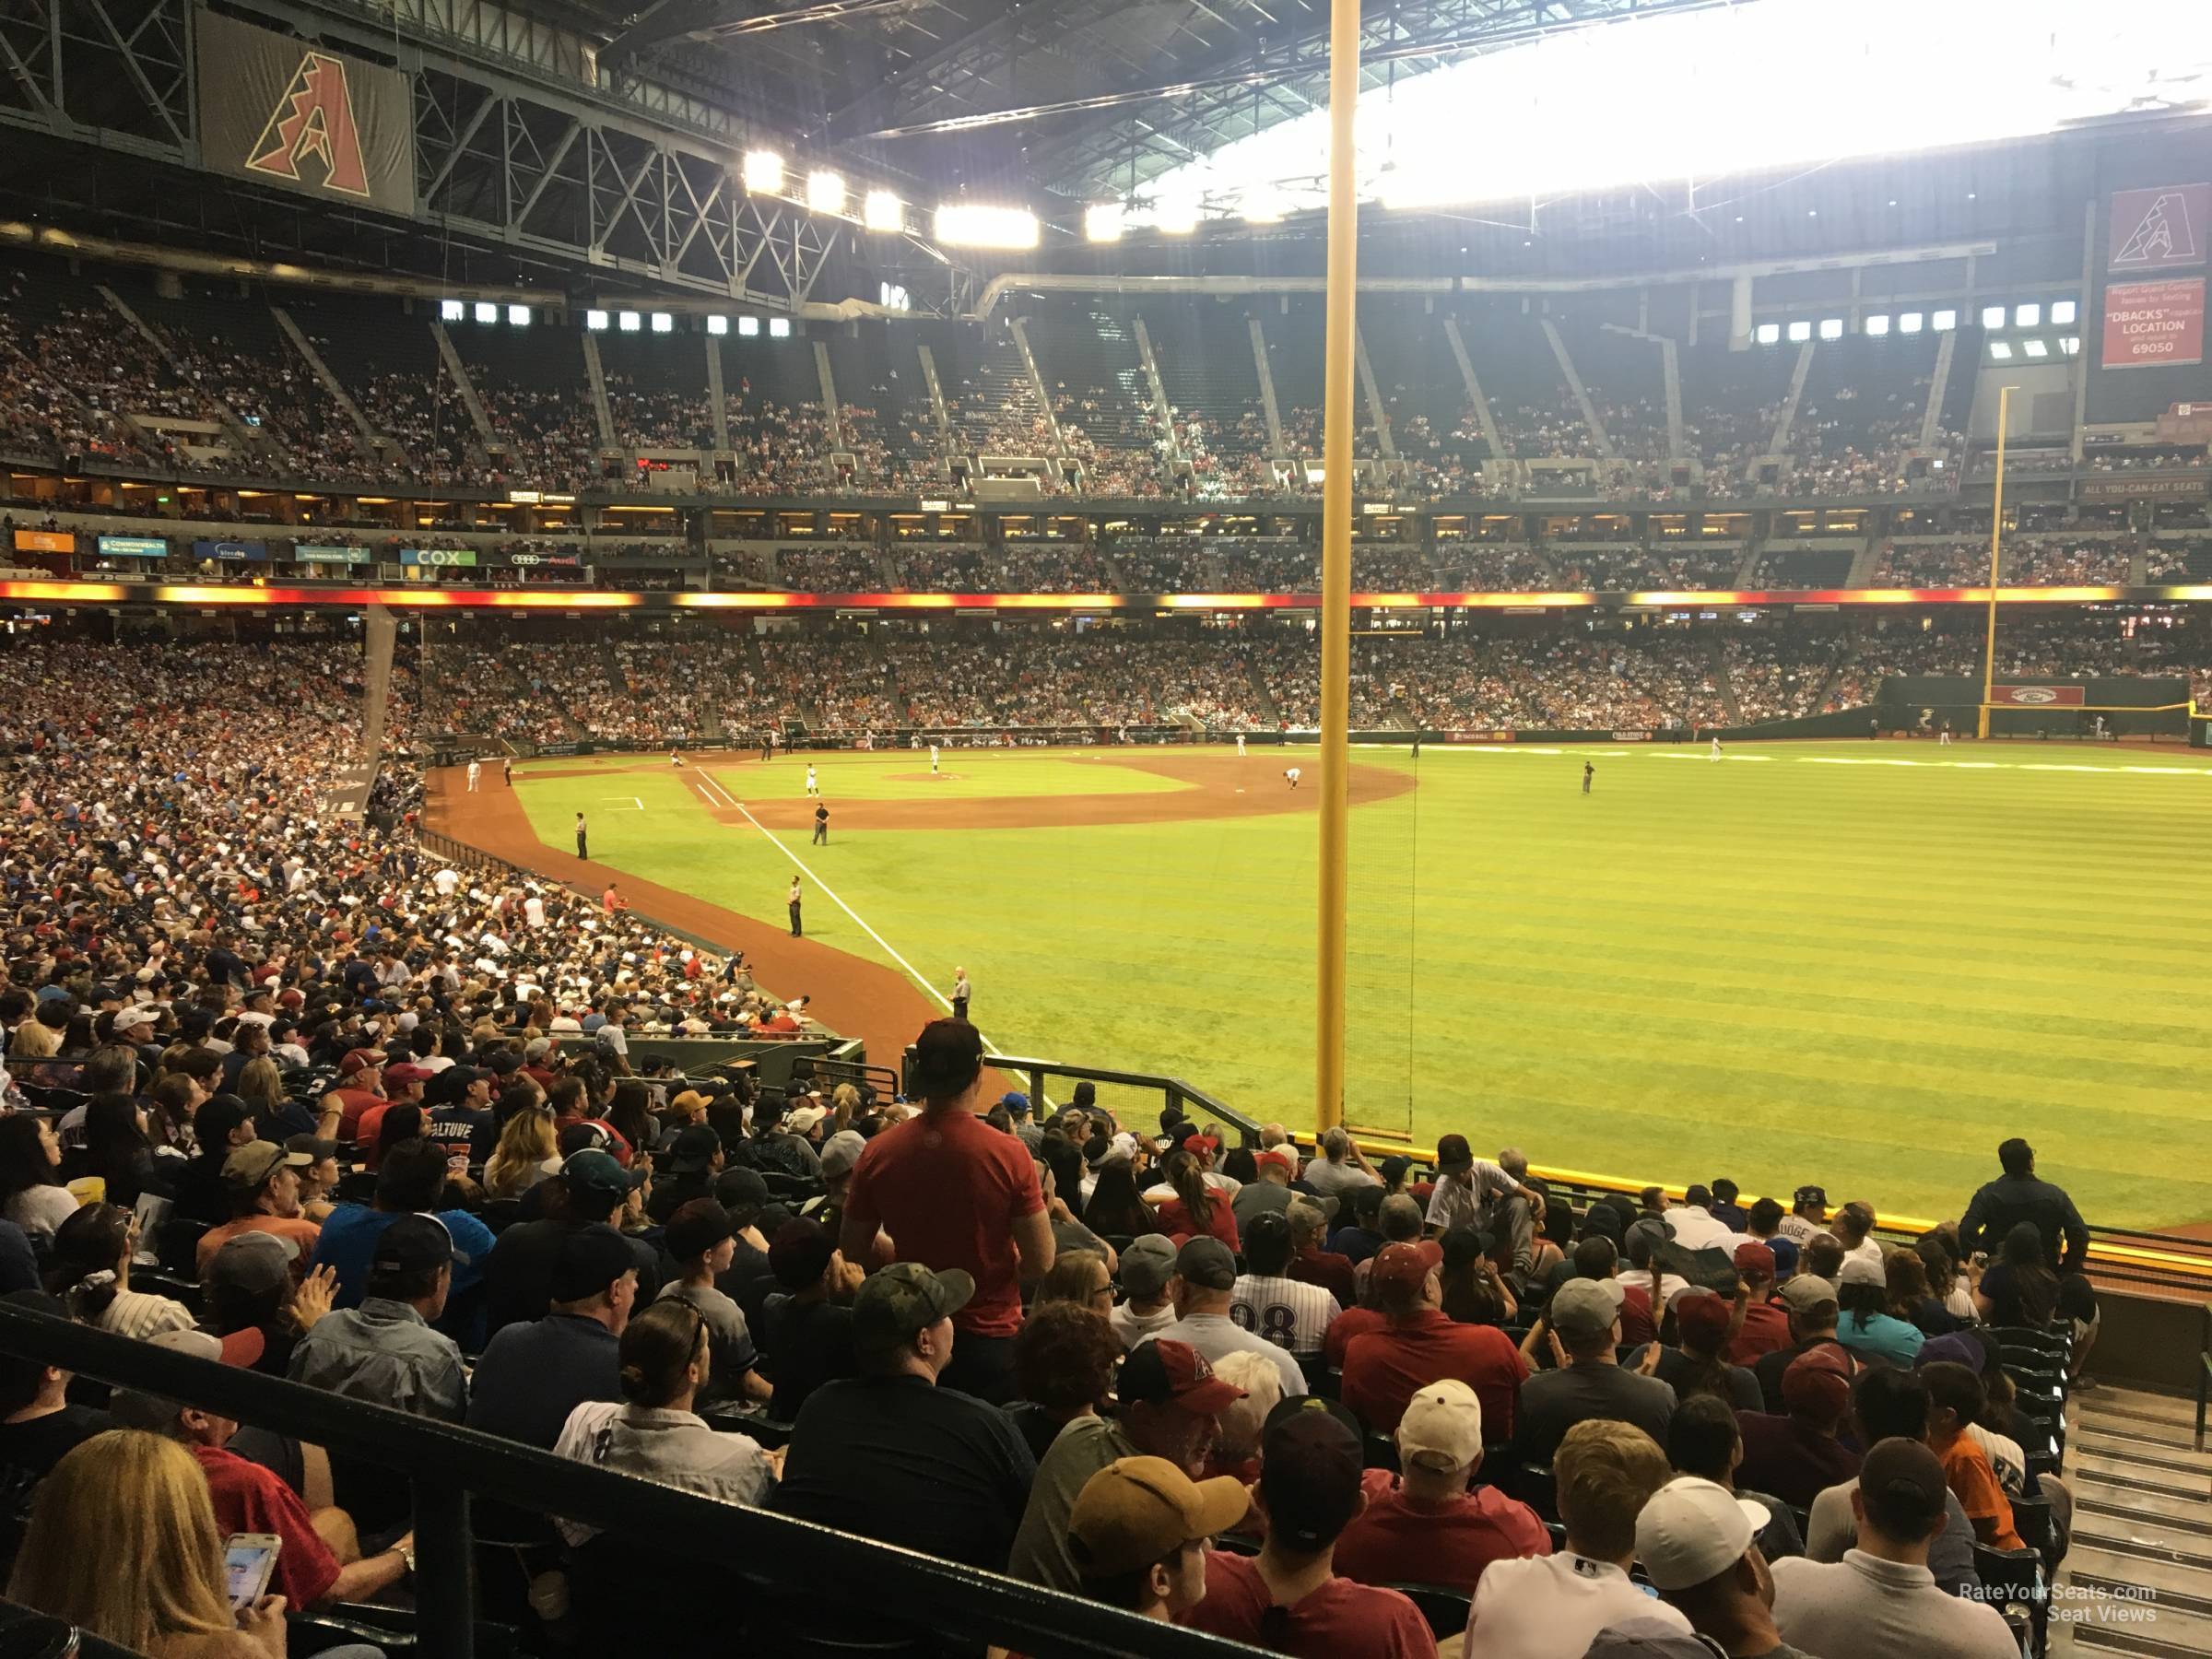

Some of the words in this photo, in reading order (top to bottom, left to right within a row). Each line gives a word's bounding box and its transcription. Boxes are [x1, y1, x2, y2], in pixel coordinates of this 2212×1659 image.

[2123, 320, 2185, 335] LOCATION
[2132, 342, 2174, 355] 69050
[2085, 485, 2102, 494] ALL
[2106, 482, 2170, 494] YOU-CAN-EAT
[2173, 481, 2205, 492] SEATS
[110, 539, 165, 549] COMMONWEALTH
[417, 550, 460, 565] COX
[547, 556, 576, 565] Audi
[431, 1123, 474, 1139] ALTUVE
